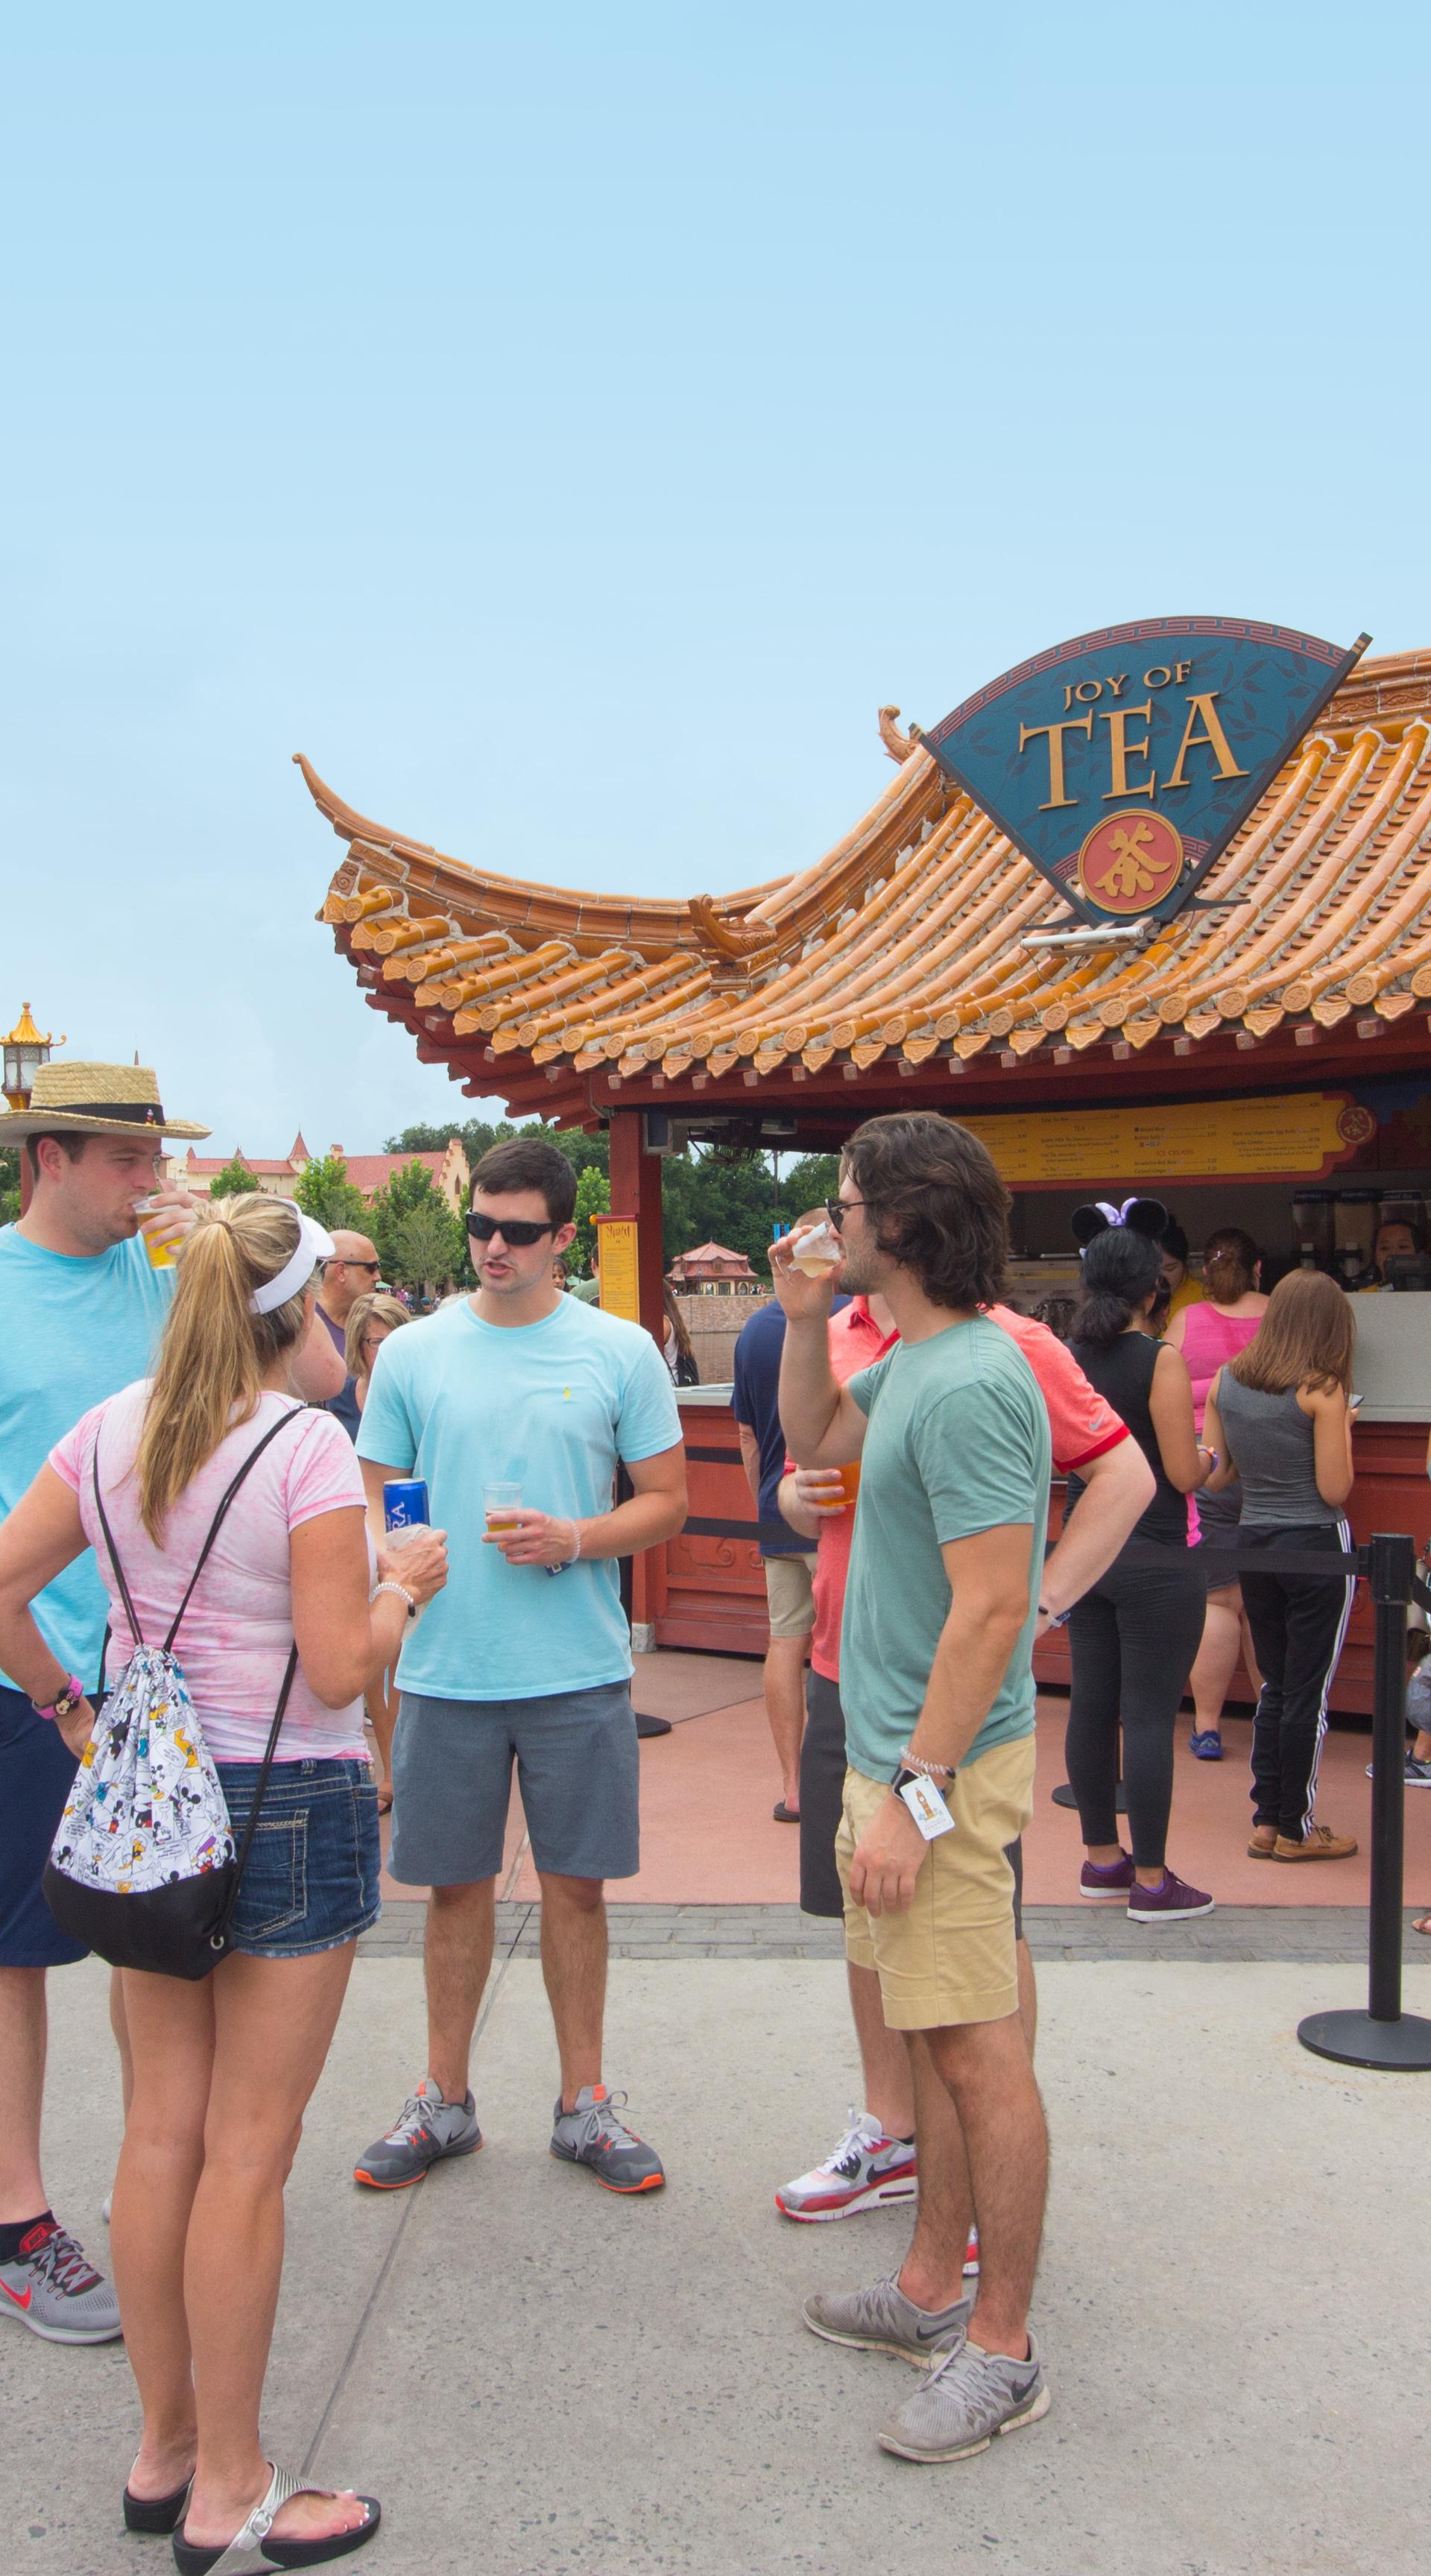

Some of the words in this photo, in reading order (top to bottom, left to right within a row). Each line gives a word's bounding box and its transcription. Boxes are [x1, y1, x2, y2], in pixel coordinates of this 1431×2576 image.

[1063, 675, 1128, 712] JOY
[1144, 660, 1192, 689] OF
[1019, 692, 1251, 812] TEA
[1093, 821, 1172, 898] 茶
